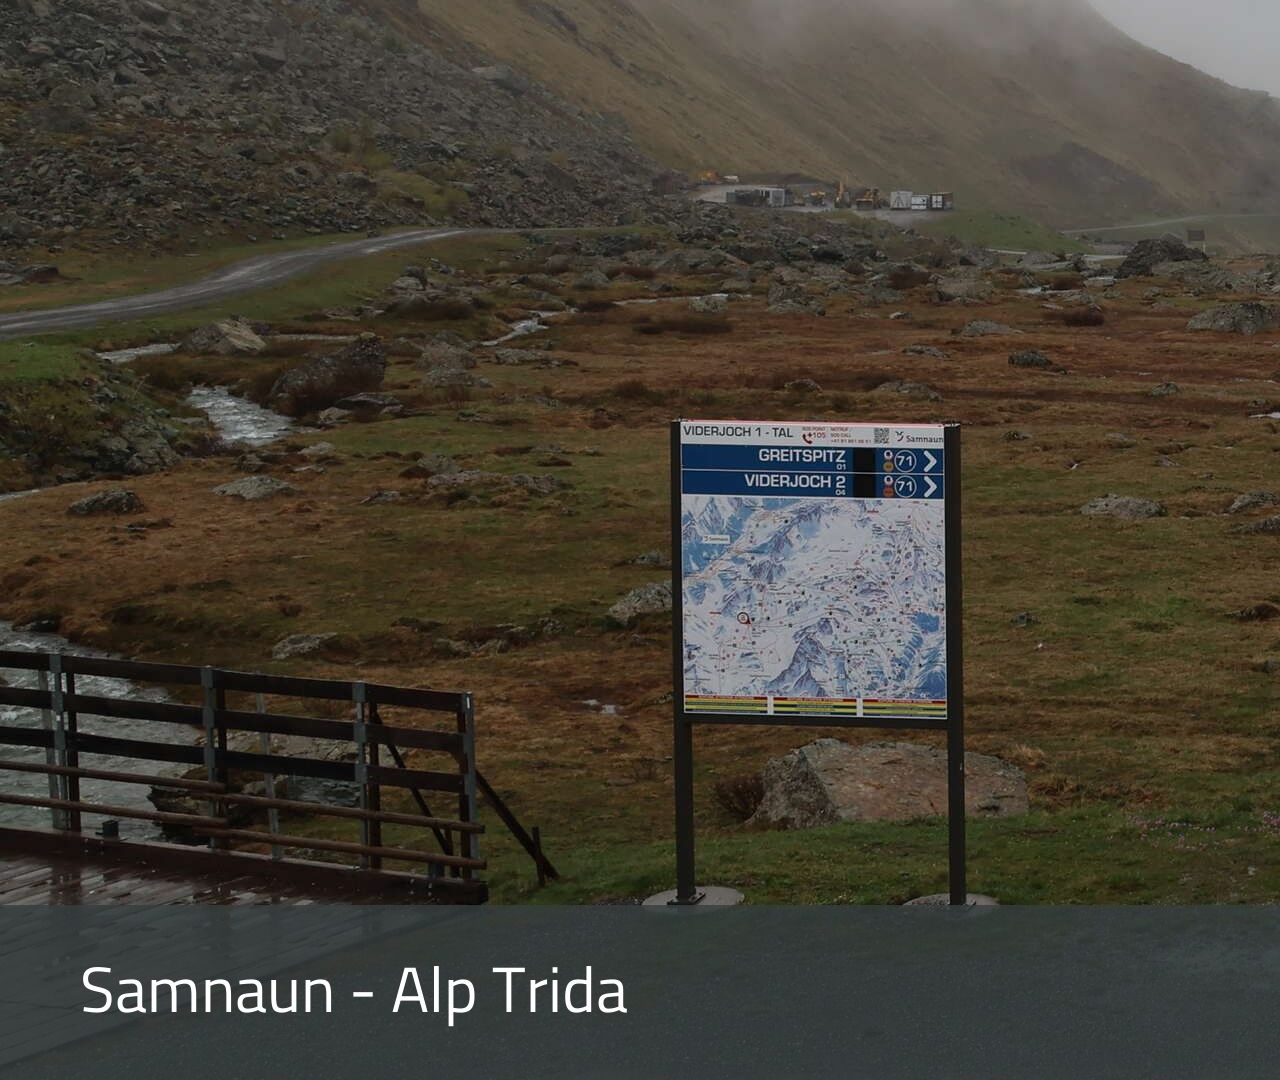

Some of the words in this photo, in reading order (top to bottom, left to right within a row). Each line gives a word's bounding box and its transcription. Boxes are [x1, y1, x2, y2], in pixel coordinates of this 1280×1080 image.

[683, 426, 751, 437] VIDERJOCH
[755, 427, 761, 437] 1
[772, 427, 793, 438] TAL
[906, 435, 944, 443] Samnaun
[758, 448, 846, 463] GREITSPITZ
[897, 455, 912, 467] 71
[744, 474, 832, 488] VIDERJOCH
[836, 475, 846, 489] 2
[897, 481, 912, 492] 71
